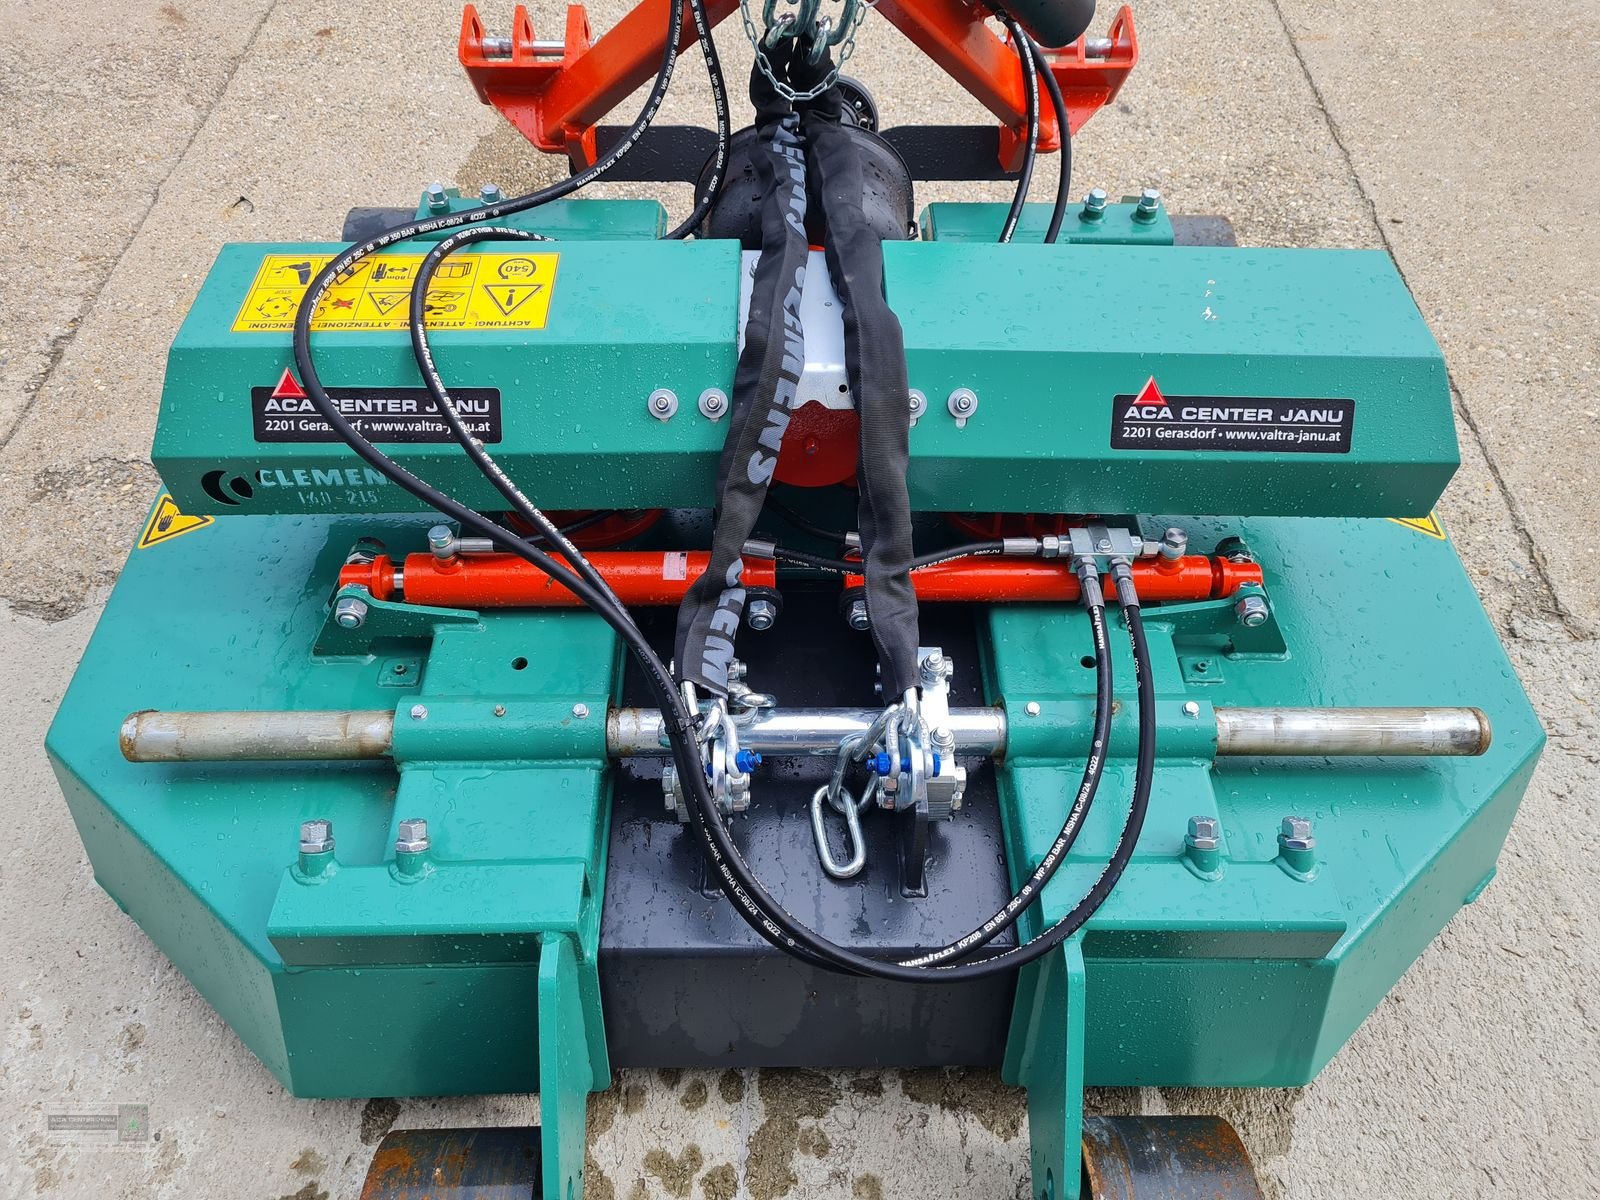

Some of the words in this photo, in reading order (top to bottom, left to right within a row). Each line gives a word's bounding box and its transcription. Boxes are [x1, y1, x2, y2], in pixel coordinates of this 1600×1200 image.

[716, 100, 725, 117] BAR
[400, 227, 416, 239] BAR
[418, 221, 439, 234] MSHA
[505, 265, 530, 273] 540
[317, 321, 391, 329] ATTENZIONE!
[399, 320, 465, 328] ATTENTN!
[264, 398, 316, 412] ACA
[425, 399, 490, 412] JNU
[1124, 405, 1174, 420] ACA
[1181, 407, 1273, 422] CENTER
[1280, 410, 1344, 423] JANU
[265, 420, 295, 431] 2201
[299, 419, 362, 432] Gerarf
[1122, 427, 1152, 438] 2201
[1155, 427, 1217, 440] Gerasdorf
[1225, 429, 1341, 444] www.valtra-janu.at
[259, 467, 391, 487] CLEMEN
[514, 489, 535, 511] MSHA
[701, 557, 747, 700] CLEM
[957, 931, 982, 950] KP208
[983, 921, 996, 933] EN
[994, 910, 1008, 924] 857
[1007, 896, 1023, 912] 2SC
[1021, 885, 1033, 896] 08
[1033, 866, 1047, 881] WP
[1044, 854, 1056, 869] 350
[1051, 837, 1067, 857] BAR
[1062, 812, 1081, 837] MSHA
[1074, 781, 1092, 814] IC-08/24
[1087, 755, 1100, 776] 4Q22
[719, 863, 737, 889] MSHA
[734, 885, 760, 916] IC-08/24
[762, 918, 782, 937] 4Q22
